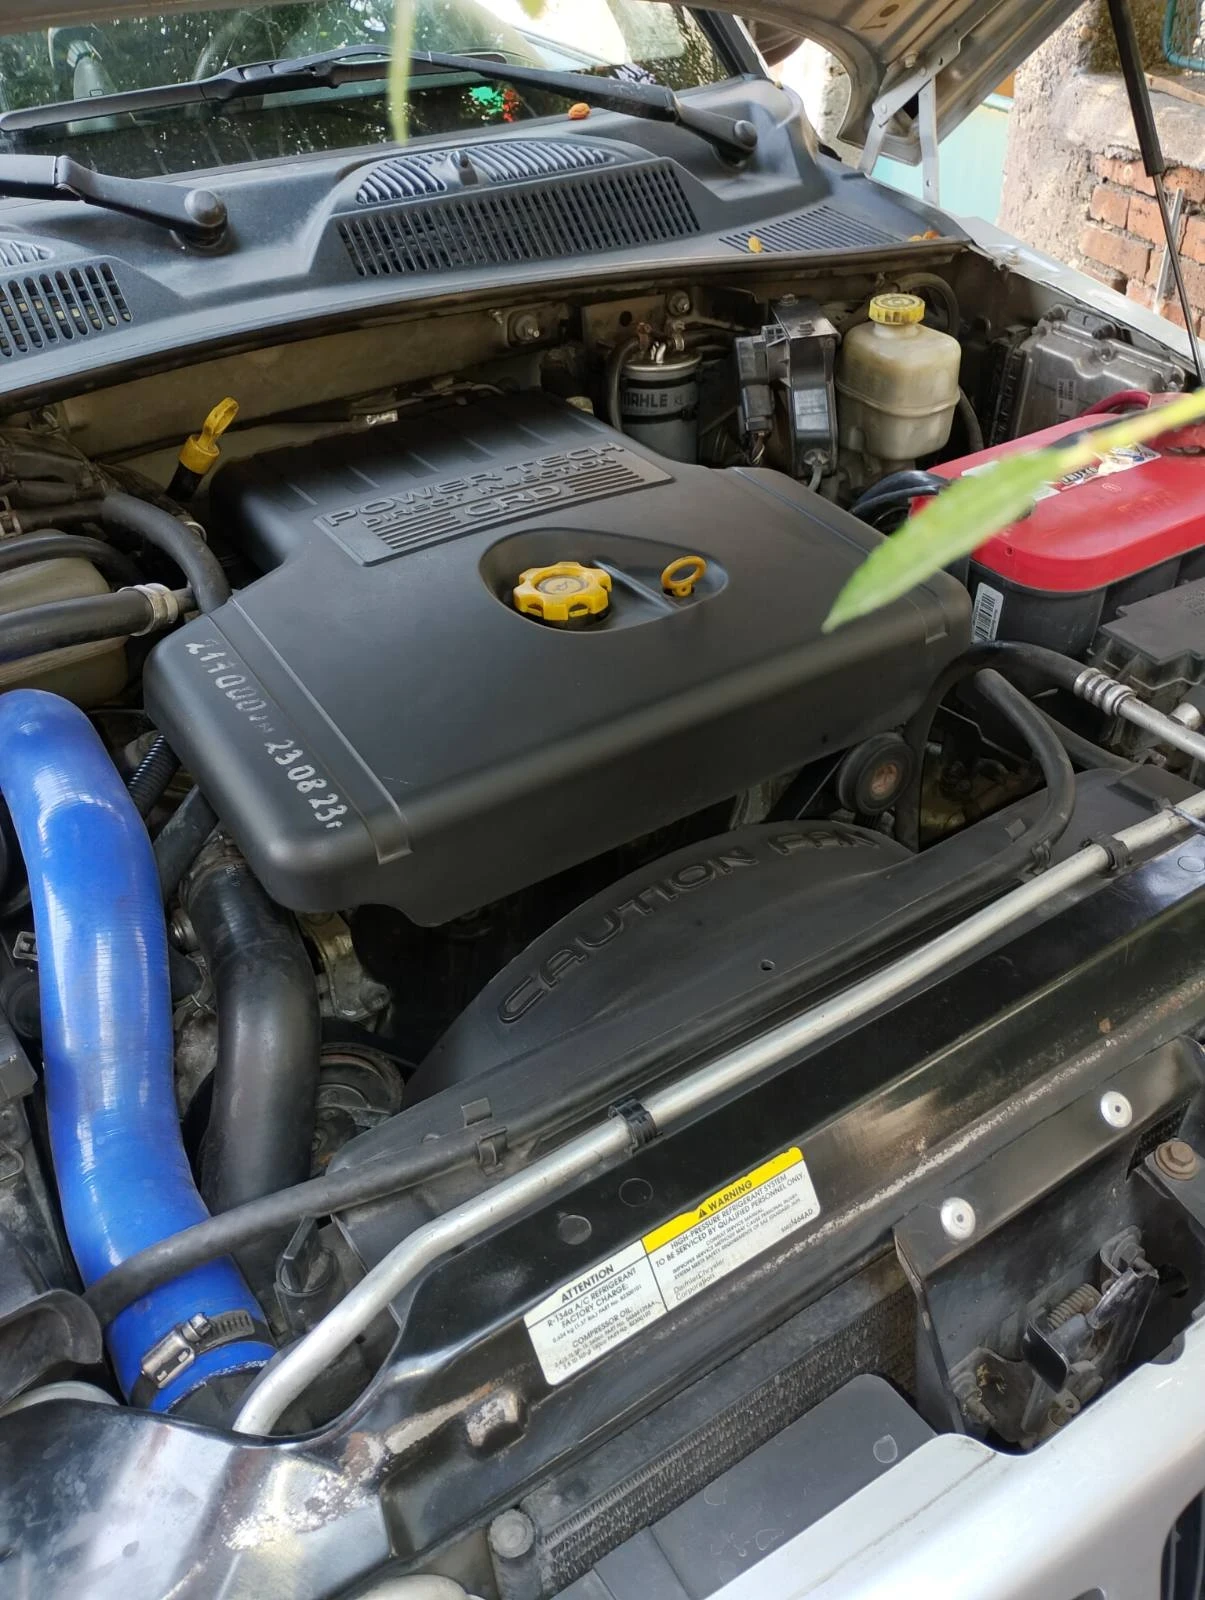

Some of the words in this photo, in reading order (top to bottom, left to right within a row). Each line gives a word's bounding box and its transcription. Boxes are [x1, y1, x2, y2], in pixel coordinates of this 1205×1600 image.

[327, 471, 503, 527] POWER
[505, 441, 625, 472] TECH
[362, 492, 463, 527] DIRECT
[478, 457, 617, 494] INJECTION
[464, 485, 564, 517] CRD
[498, 848, 759, 1023] CAUTION
[767, 828, 880, 857] FAN
[670, 1214, 720, 1249] HIGH-PRESSURE
[721, 1188, 763, 1217] REFRIGERANT
[763, 1173, 786, 1192] SYSTEM
[708, 1179, 752, 1211] WARNING
[656, 1257, 665, 1267] TO
[666, 1251, 674, 1260] BE
[675, 1232, 706, 1255] SERVICED
[708, 1226, 716, 1235] BY
[717, 1205, 749, 1229] QUALIFIED
[750, 1183, 785, 1208] PERSONNEL
[547, 1306, 572, 1327] R-134a
[574, 1296, 589, 1310] A/C
[590, 1267, 636, 1300] REFRIGERANT
[560, 1264, 613, 1302] ATTENTION
[675, 1271, 714, 1301] Corporation
[561, 1303, 593, 1328] FACTORY
[572, 1314, 619, 1348] COMPRESSOR
